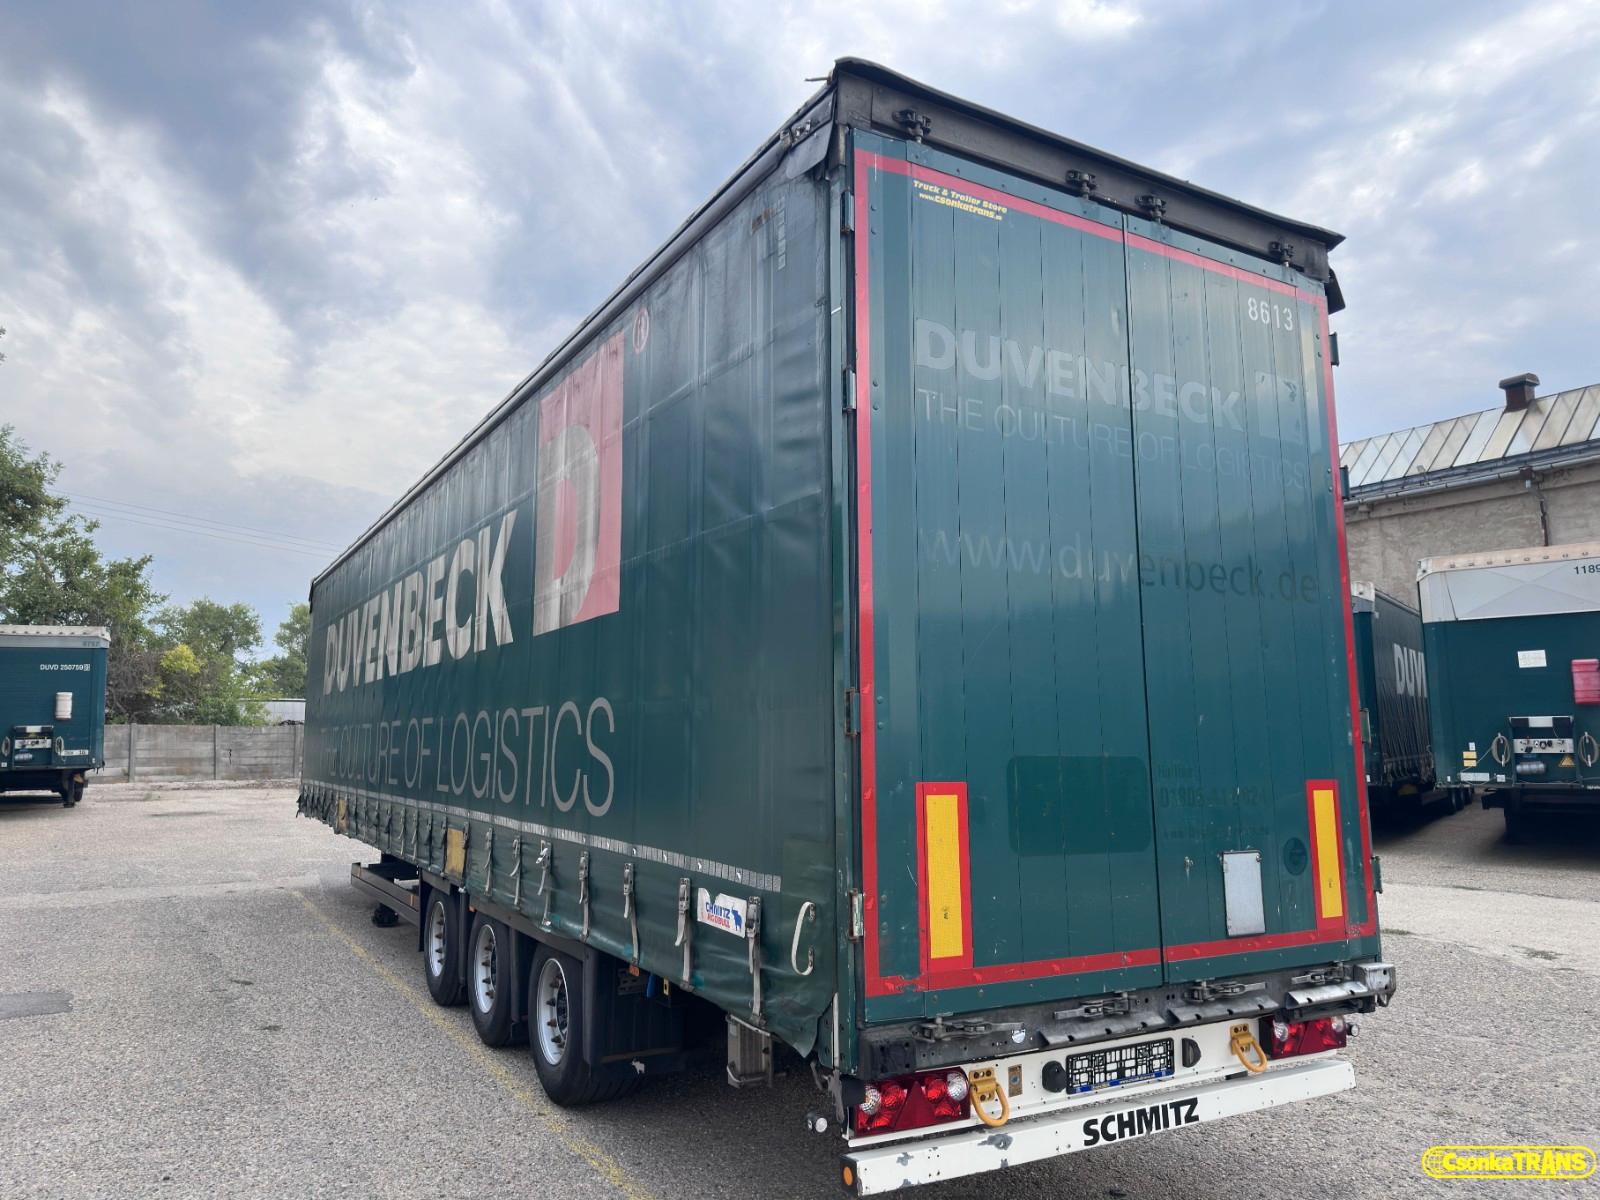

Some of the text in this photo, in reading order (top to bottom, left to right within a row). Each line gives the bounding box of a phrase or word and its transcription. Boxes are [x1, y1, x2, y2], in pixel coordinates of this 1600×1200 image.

[1247, 297, 1293, 331] 8613
[915, 318, 1244, 432] DUVENBECK
[917, 387, 984, 432] THE
[1138, 432, 1175, 465] OF
[323, 508, 518, 696] DUVENBECK
[921, 528, 1319, 605] www.duvenbeck.de
[1393, 643, 1428, 698] DUV
[404, 716, 434, 789] OF
[436, 697, 615, 817] LOGISTICS
[1083, 1097, 1200, 1147] SCHMITZ
